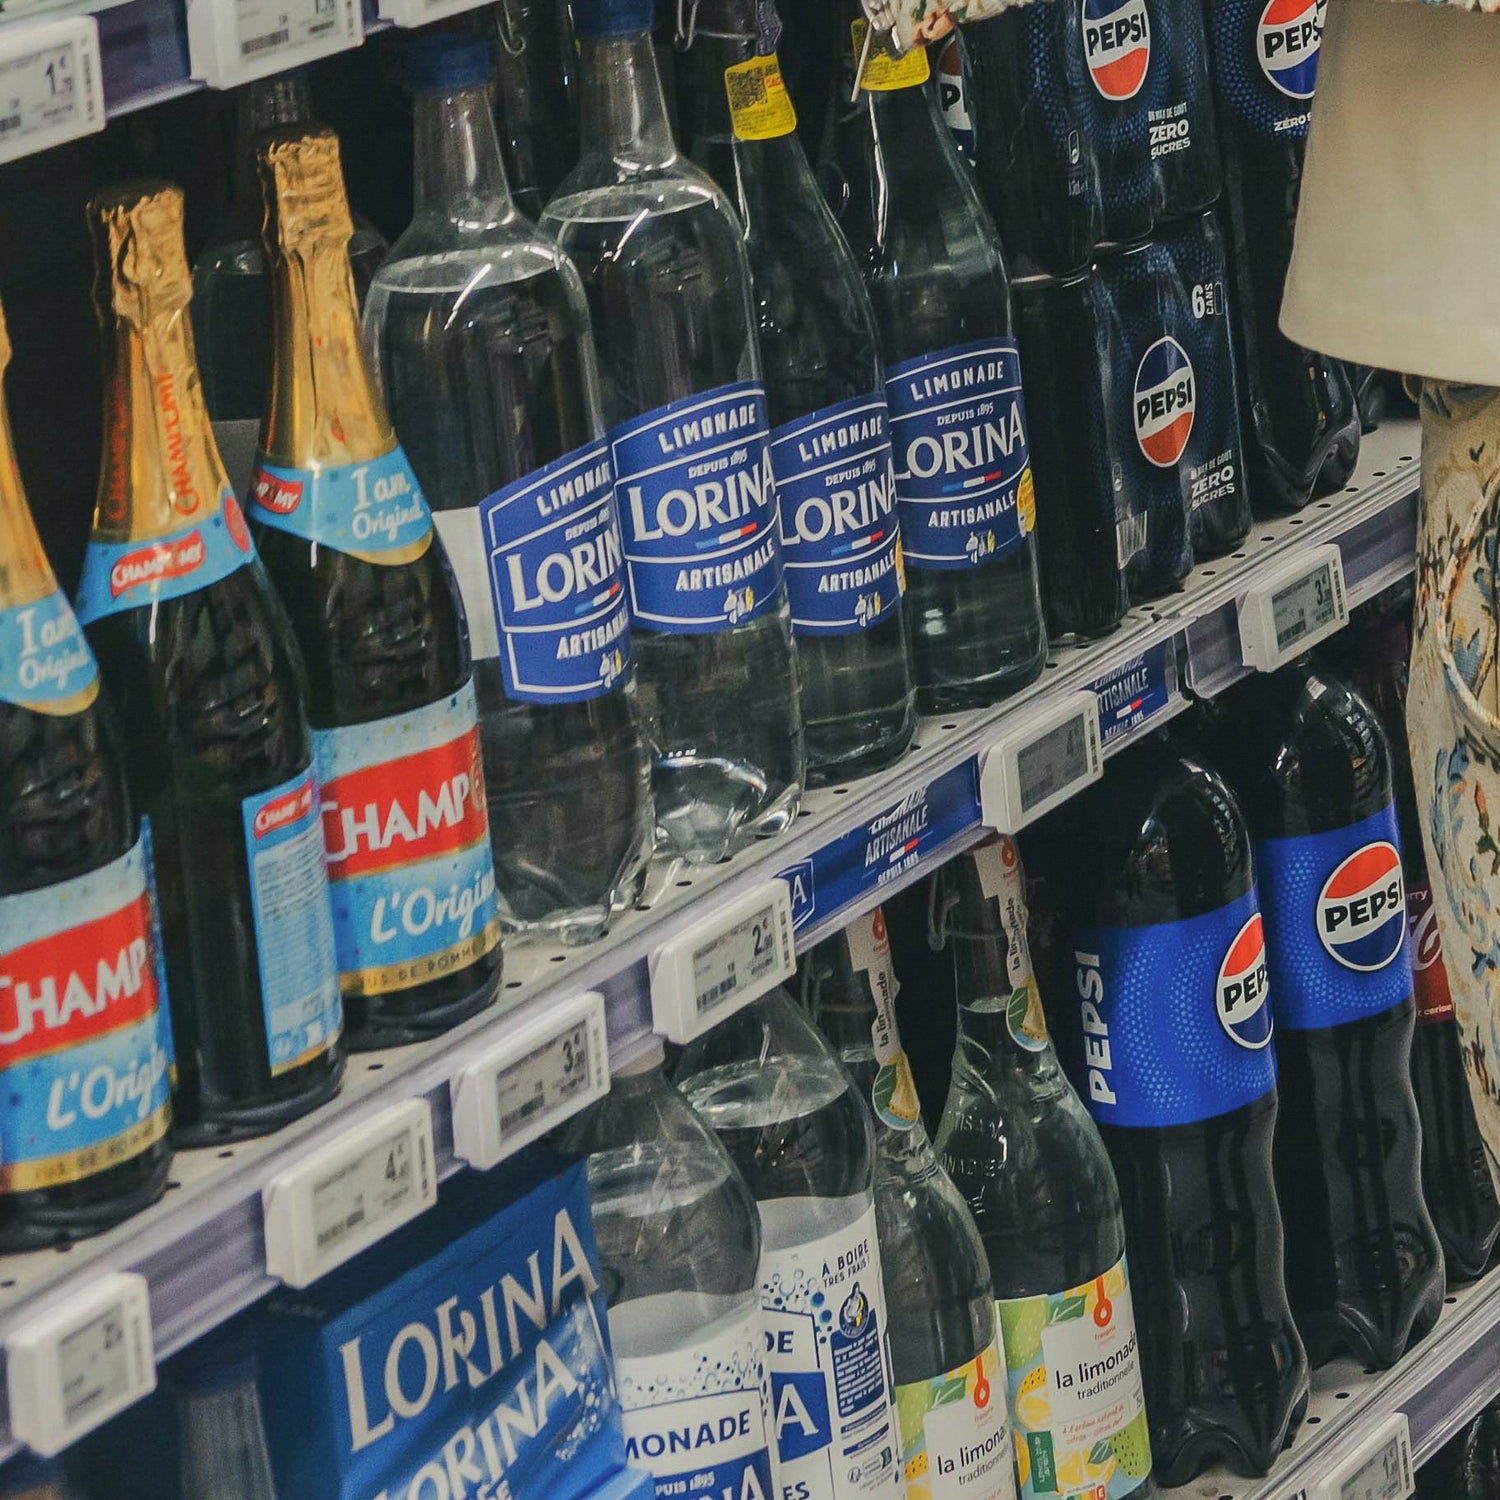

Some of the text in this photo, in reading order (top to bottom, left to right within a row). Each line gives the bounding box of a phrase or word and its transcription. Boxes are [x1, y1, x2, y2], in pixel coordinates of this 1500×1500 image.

[1085, 11, 1148, 58] PEPSI
[1149, 118, 1190, 145] ZÉRO
[1273, 111, 1307, 132] ZÉRO
[1150, 136, 1191, 160] SUCRES
[1191, 284, 1206, 319] 6
[1205, 282, 1214, 315] CANS
[910, 360, 1005, 402] LIMONADE
[936, 401, 995, 426] DEPUIS 1895
[1136, 376, 1193, 428] PEPSI
[658, 403, 757, 454] LIMONADE
[798, 414, 883, 463] LIMONADE
[688, 457, 728, 480] DEPUIS
[825, 466, 861, 487] DEPUIS
[1191, 464, 1235, 500] ZÉRO
[626, 445, 777, 543] LORINA
[776, 456, 898, 546] LORINA
[928, 488, 1016, 528] ARTISANALE
[1191, 482, 1236, 512] SUCRES
[675, 537, 776, 592] ARTISANALE
[817, 549, 896, 594] ARTISANALE
[865, 804, 929, 868] ARTISANALE
[1075, 950, 1117, 1106] PEPSI
[837, 1239, 869, 1271] BOIRE
[338, 1207, 600, 1453] LORINA
[1055, 1370, 1074, 1390] la
[372, 1338, 579, 1500] ORINA
[937, 1455, 955, 1476] la
